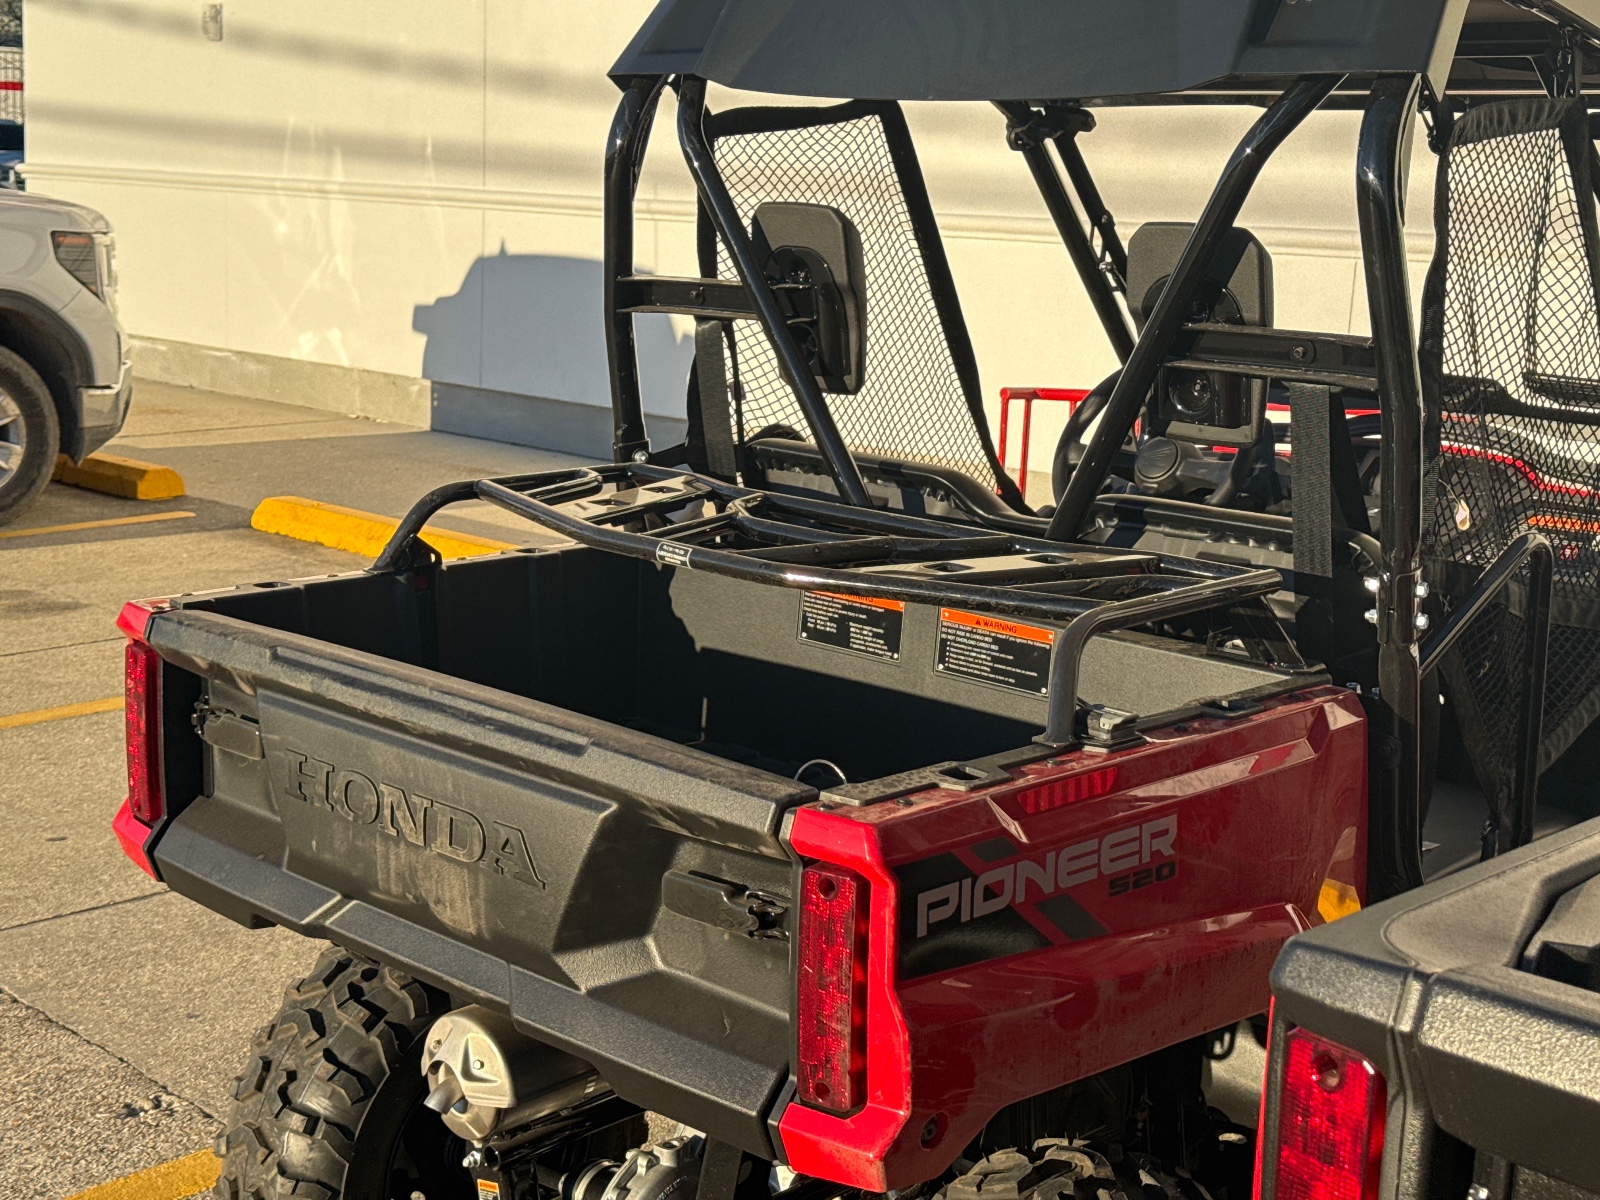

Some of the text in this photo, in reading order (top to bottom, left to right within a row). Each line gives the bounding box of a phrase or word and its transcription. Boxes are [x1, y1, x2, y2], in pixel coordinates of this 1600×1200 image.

[956, 636, 976, 646] OVERLOAD
[983, 618, 1017, 633] WARNING
[285, 747, 547, 890] HONDA
[916, 813, 1178, 938] PIONEER
[1108, 860, 1176, 897] 520
